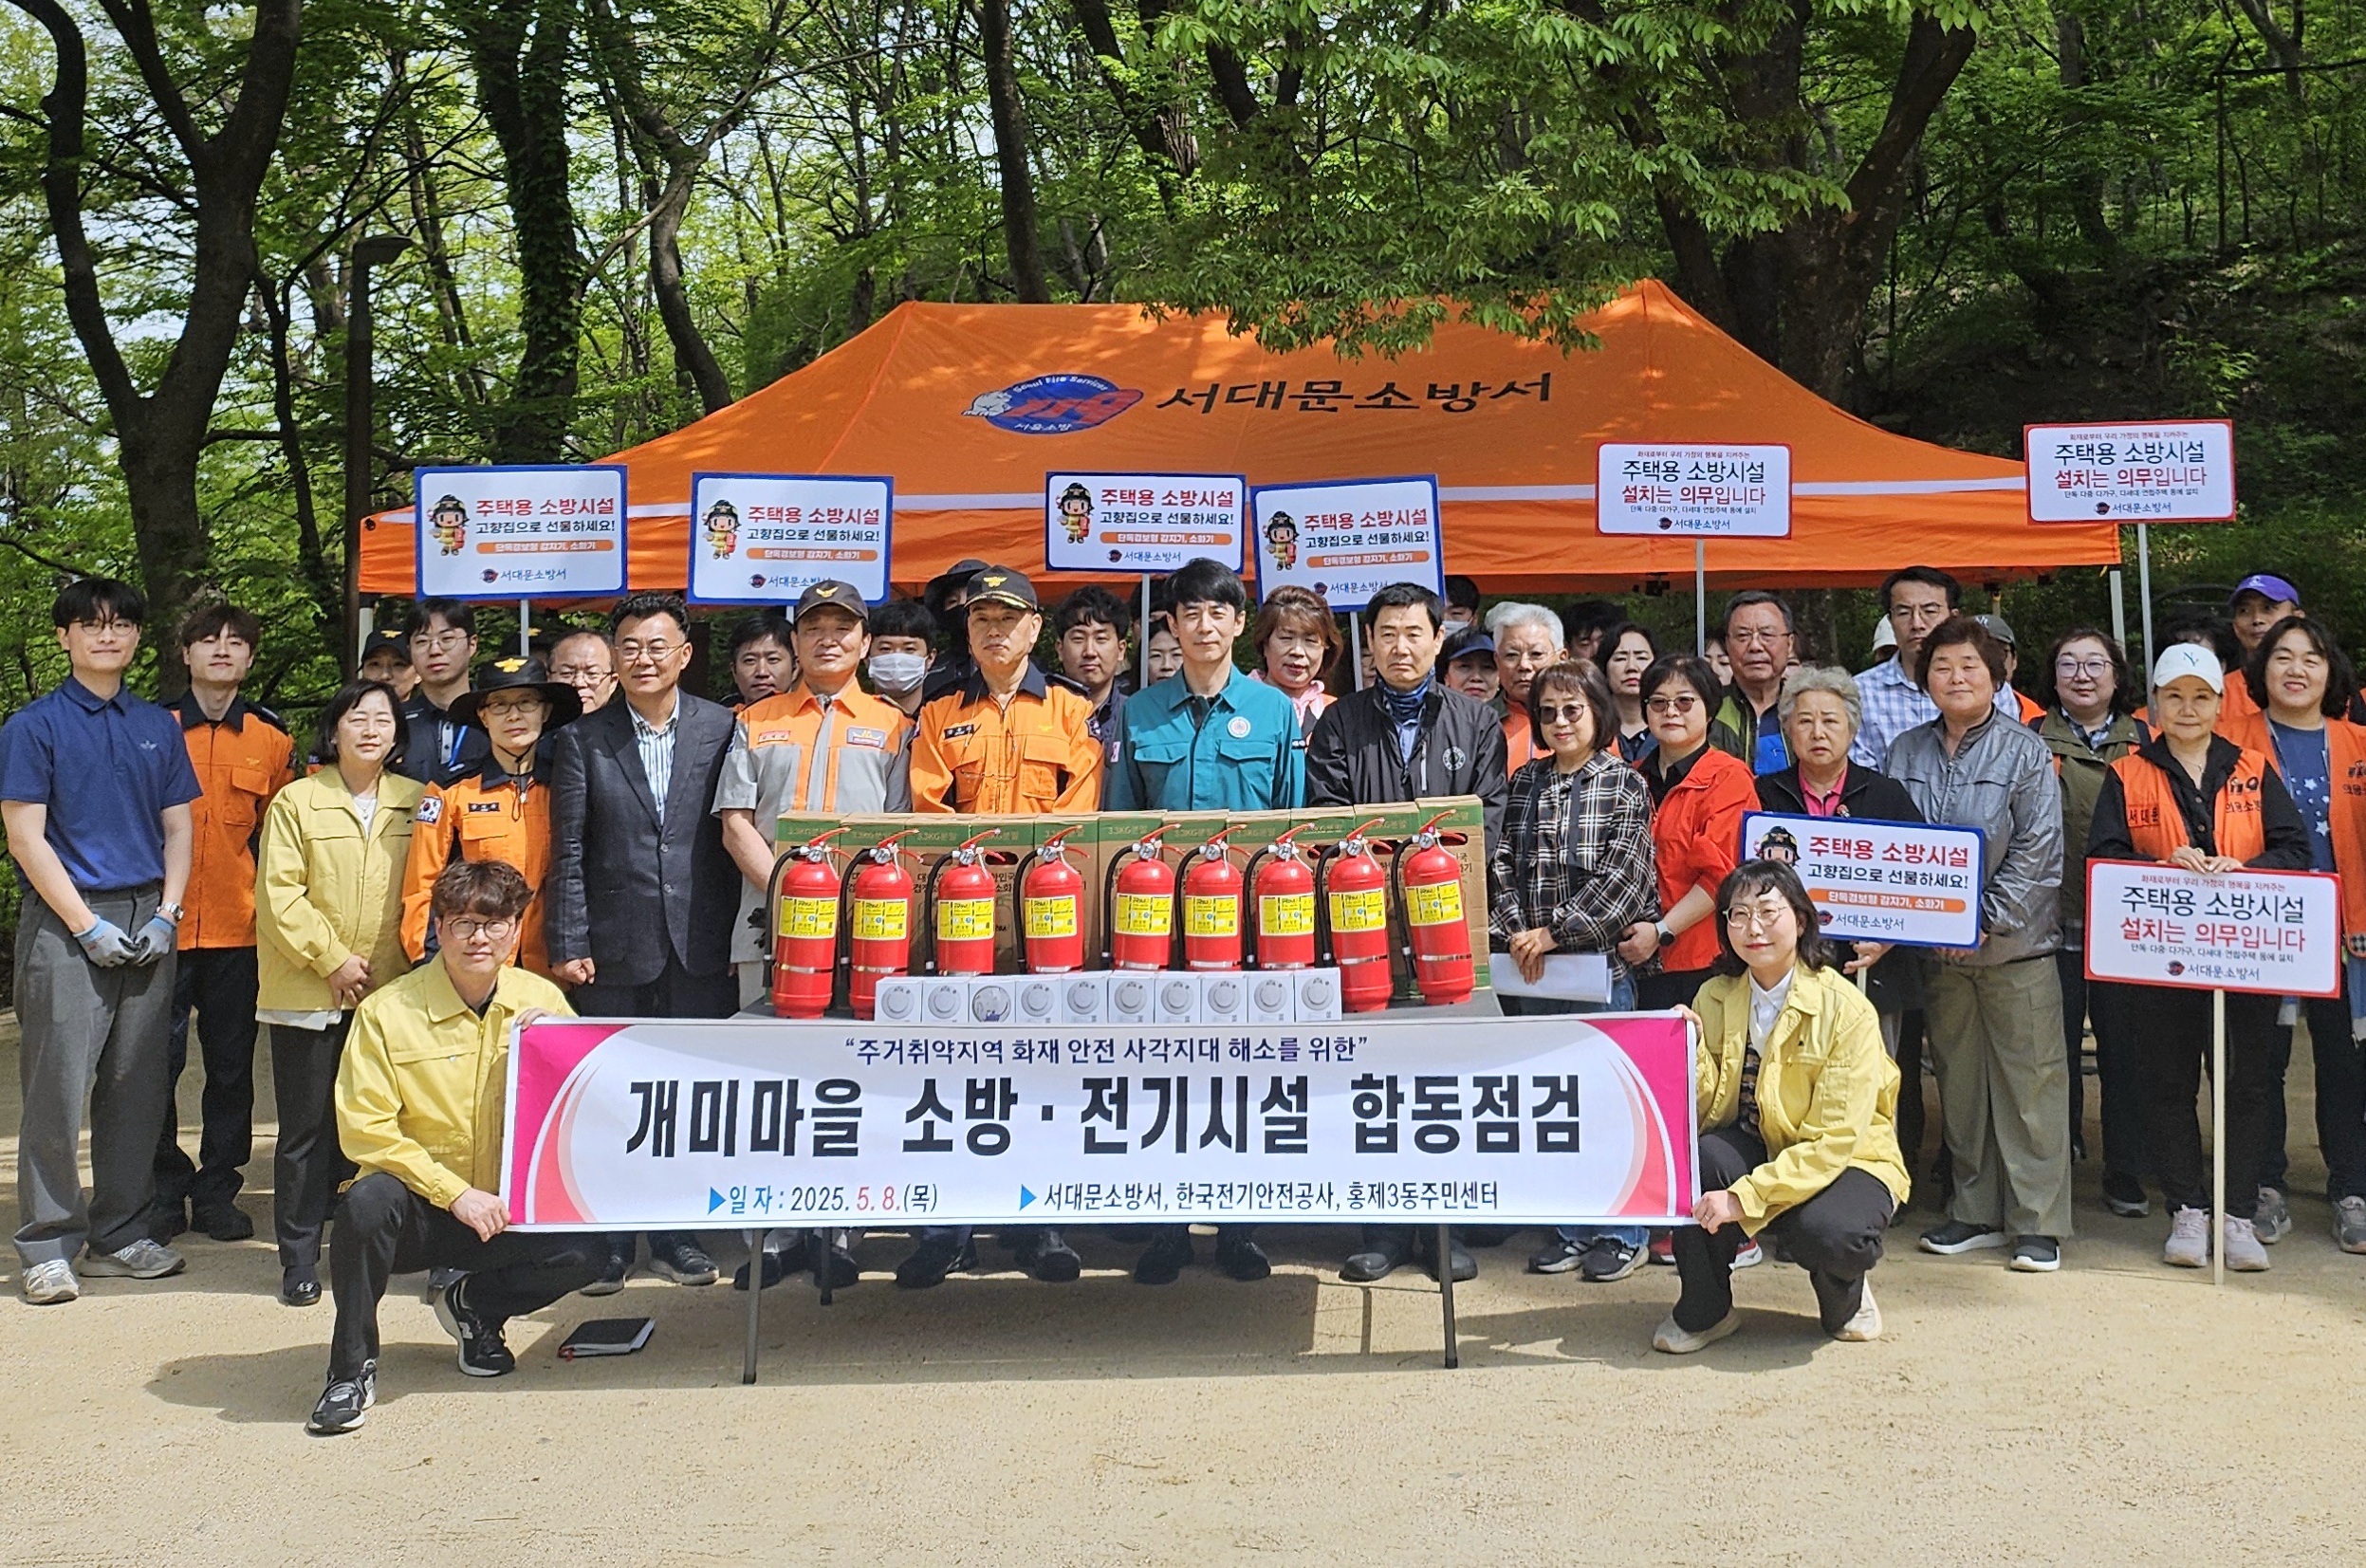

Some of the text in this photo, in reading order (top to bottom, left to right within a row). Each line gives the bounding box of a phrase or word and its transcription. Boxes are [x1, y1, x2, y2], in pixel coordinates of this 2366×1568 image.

[1045, 376, 1067, 384] Fire
[1069, 376, 1109, 392] Services
[1155, 372, 1552, 415] 서대문소방서
[2054, 440, 2206, 467] 주택용 소방시설
[1622, 460, 1765, 483] 주택용 소방시설
[2054, 467, 2208, 489] 설치는 의무입니다
[1100, 489, 1233, 507] 주택용 소방시설
[1622, 485, 1765, 506] 설치는 의무입니다
[476, 497, 615, 517] 주택용 소방시설
[748, 507, 879, 526] 주택용 소방시설
[2112, 502, 2172, 513] 서대문소방서
[475, 520, 615, 534] 고향집으로 선물하세요!
[1100, 511, 1234, 526] 고향집으로 선물하세요!
[1304, 508, 1428, 532] 주택용 소방시설
[1674, 519, 1730, 529] 서대문소방서
[747, 528, 880, 542] 고향집으로 선물하세요!
[1305, 530, 1430, 548] 고향집으로 선물하세요!
[1124, 551, 1181, 563] 서대문소방서
[500, 568, 566, 581] 서대문소방서
[1809, 836, 1969, 868] 주택용 소방시설
[1807, 863, 1969, 890] 고향집으로 선물하세요!
[2120, 885, 2305, 924] 주택용 소방시설
[1836, 913, 1905, 931] 서대문소방서
[2119, 916, 2306, 952] 설치는 의무입니다
[2188, 963, 2260, 981] 서대문소방서
[845, 1036, 1368, 1065] “주거취약지역 화재 안전 사각지대 해소를 위한”
[625, 1078, 863, 1158] 개미마을
[1350, 1073, 1581, 1154] 합동점검
[1044, 1180, 1498, 1212] 서대문소방서, 한국전기안전공사, 홍제3동주민센터
